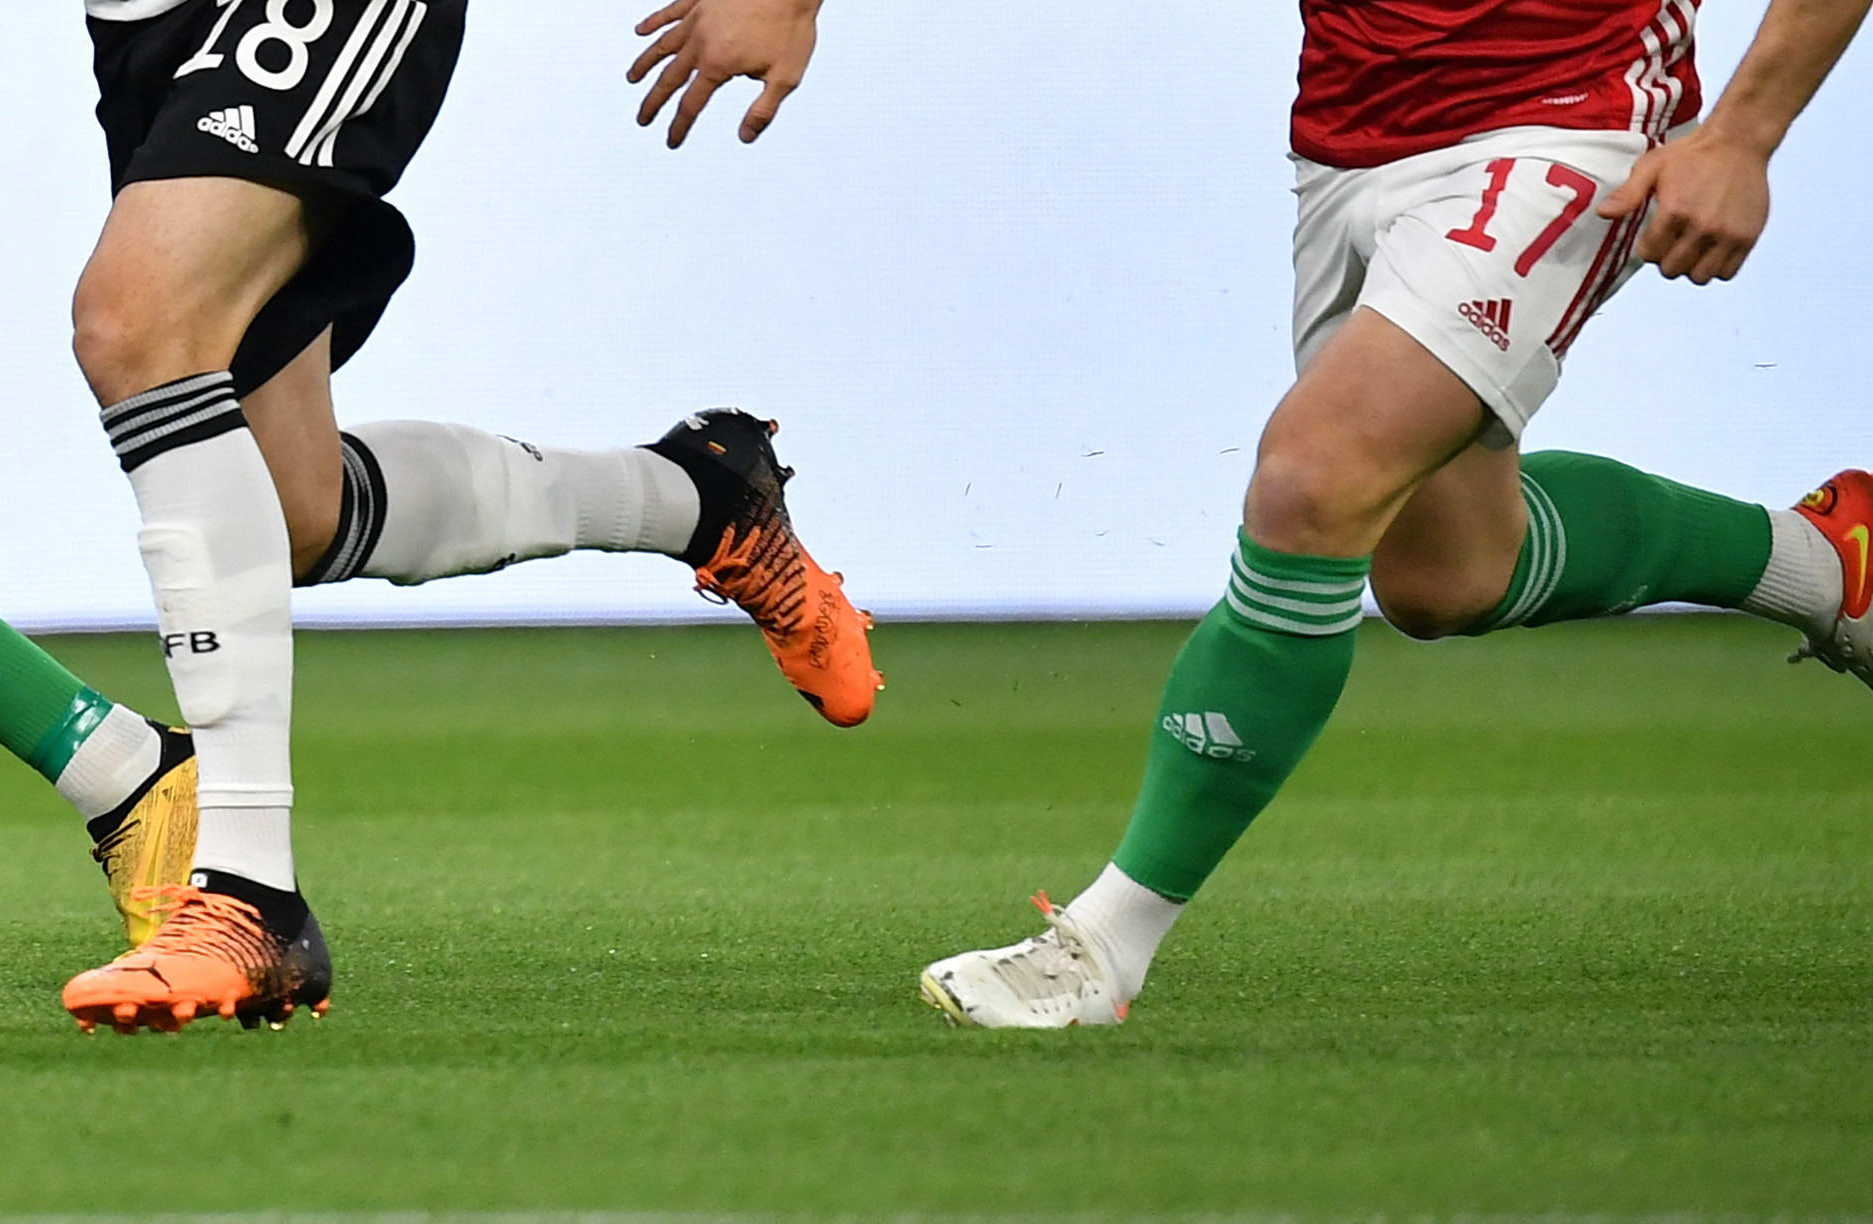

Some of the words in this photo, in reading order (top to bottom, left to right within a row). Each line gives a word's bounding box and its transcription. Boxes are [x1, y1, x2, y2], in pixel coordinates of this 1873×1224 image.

[1445, 157, 1597, 278] 17
[1458, 302, 1511, 352] adidas
[1162, 715, 1257, 762] adidas
